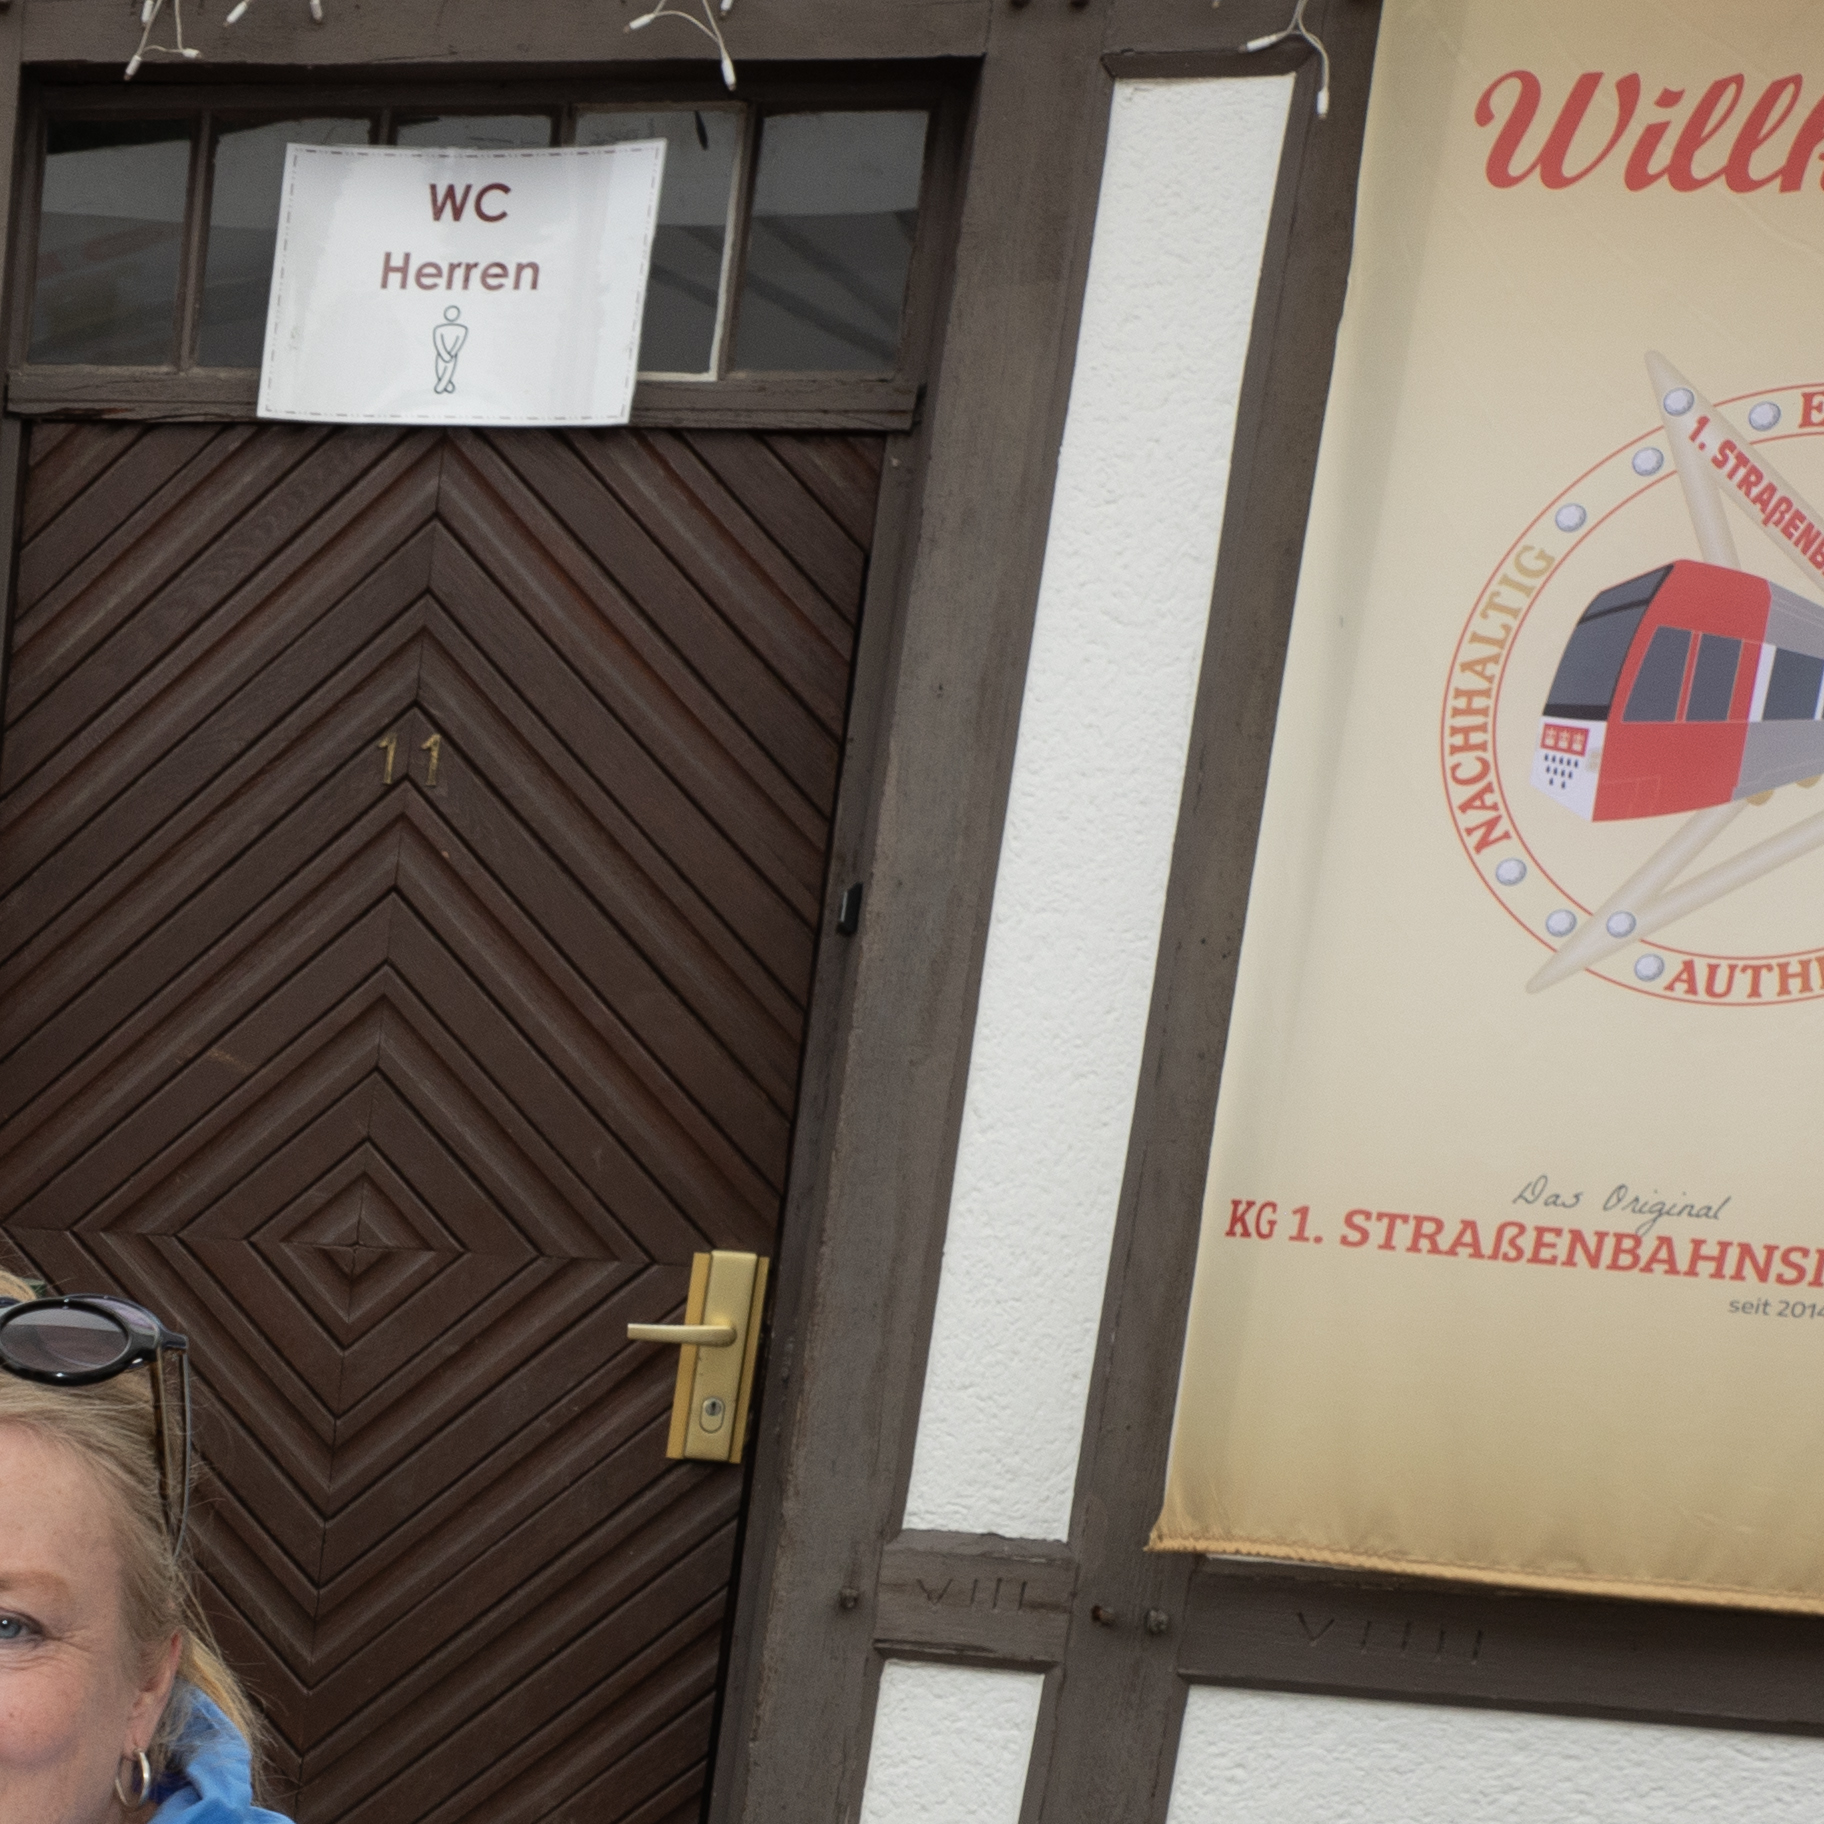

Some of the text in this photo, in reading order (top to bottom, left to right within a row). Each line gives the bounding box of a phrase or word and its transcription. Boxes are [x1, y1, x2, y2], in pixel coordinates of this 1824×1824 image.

[429, 182, 512, 223] WC
[380, 251, 540, 291] Herren
[1711, 439, 1824, 577] STRAßENB
[1449, 544, 1555, 856] NACHHALTIG
[377, 733, 441, 787] 11
[1663, 956, 1824, 999] AUTH
[1225, 1199, 1278, 1240] KG
[1604, 1184, 1732, 1239] Original
[1729, 1298, 1771, 1316] seit
